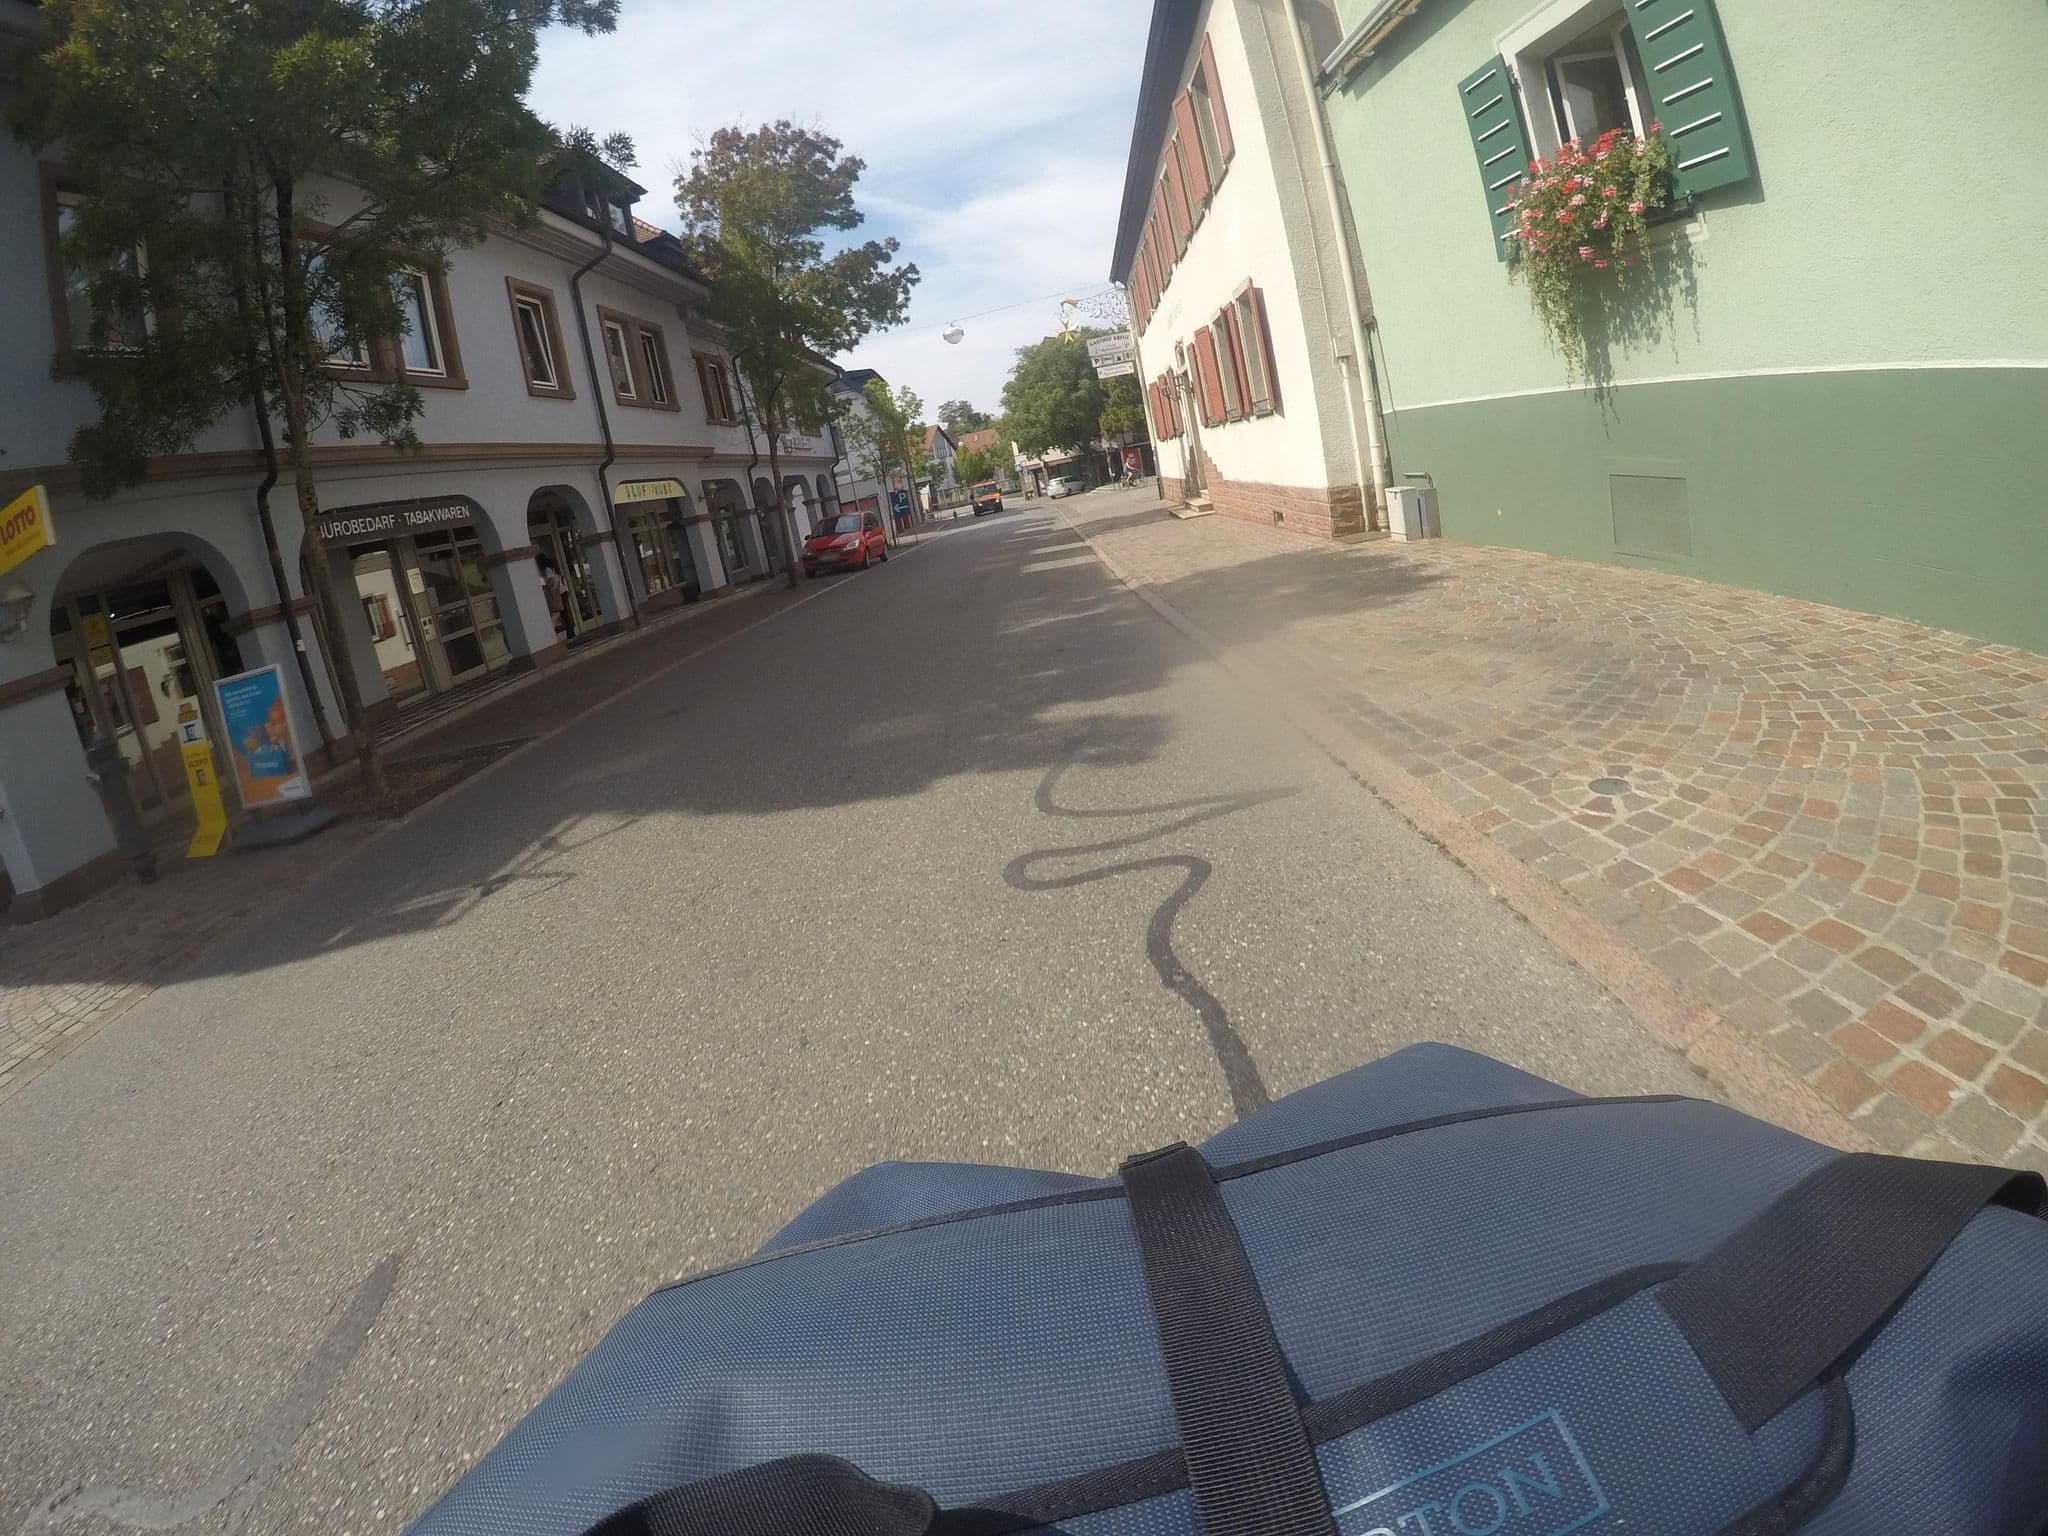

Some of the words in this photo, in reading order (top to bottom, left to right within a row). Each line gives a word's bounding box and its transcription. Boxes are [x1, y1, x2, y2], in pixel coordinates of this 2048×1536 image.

[898, 492, 907, 504] P
[0, 504, 36, 546] LOTTO
[403, 505, 470, 526] TABAKWAREN
[1357, 1450, 1561, 1536] TON
